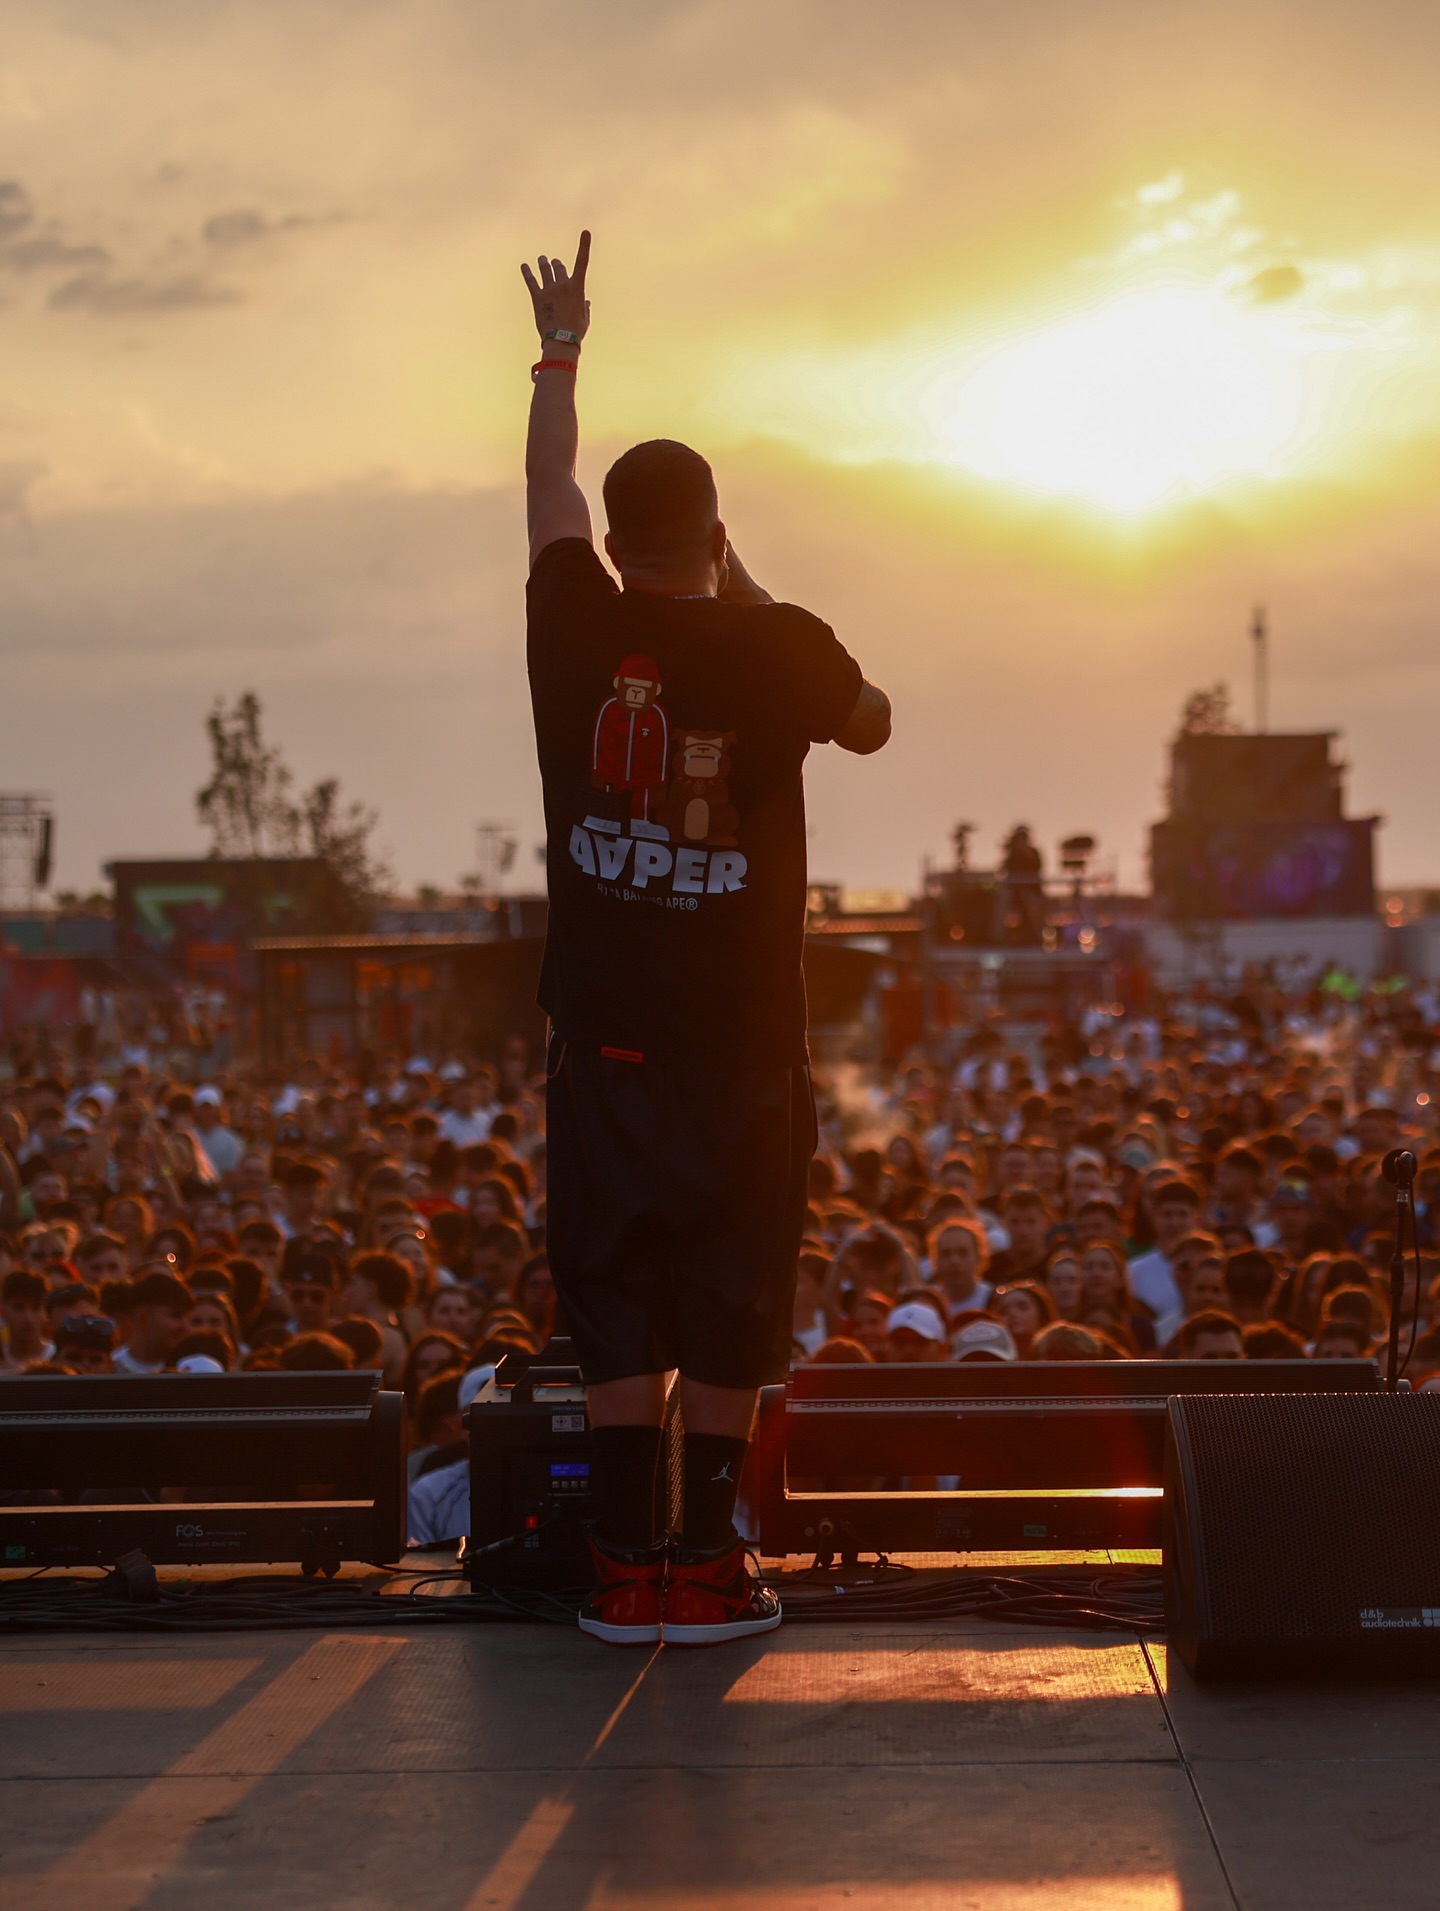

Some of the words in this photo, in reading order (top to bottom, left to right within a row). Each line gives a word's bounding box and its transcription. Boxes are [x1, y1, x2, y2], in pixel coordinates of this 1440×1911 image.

[175, 1523, 204, 1538] FOS
[1360, 1608, 1384, 1619] d&b
[1361, 1617, 1421, 1628] audiotechnik
